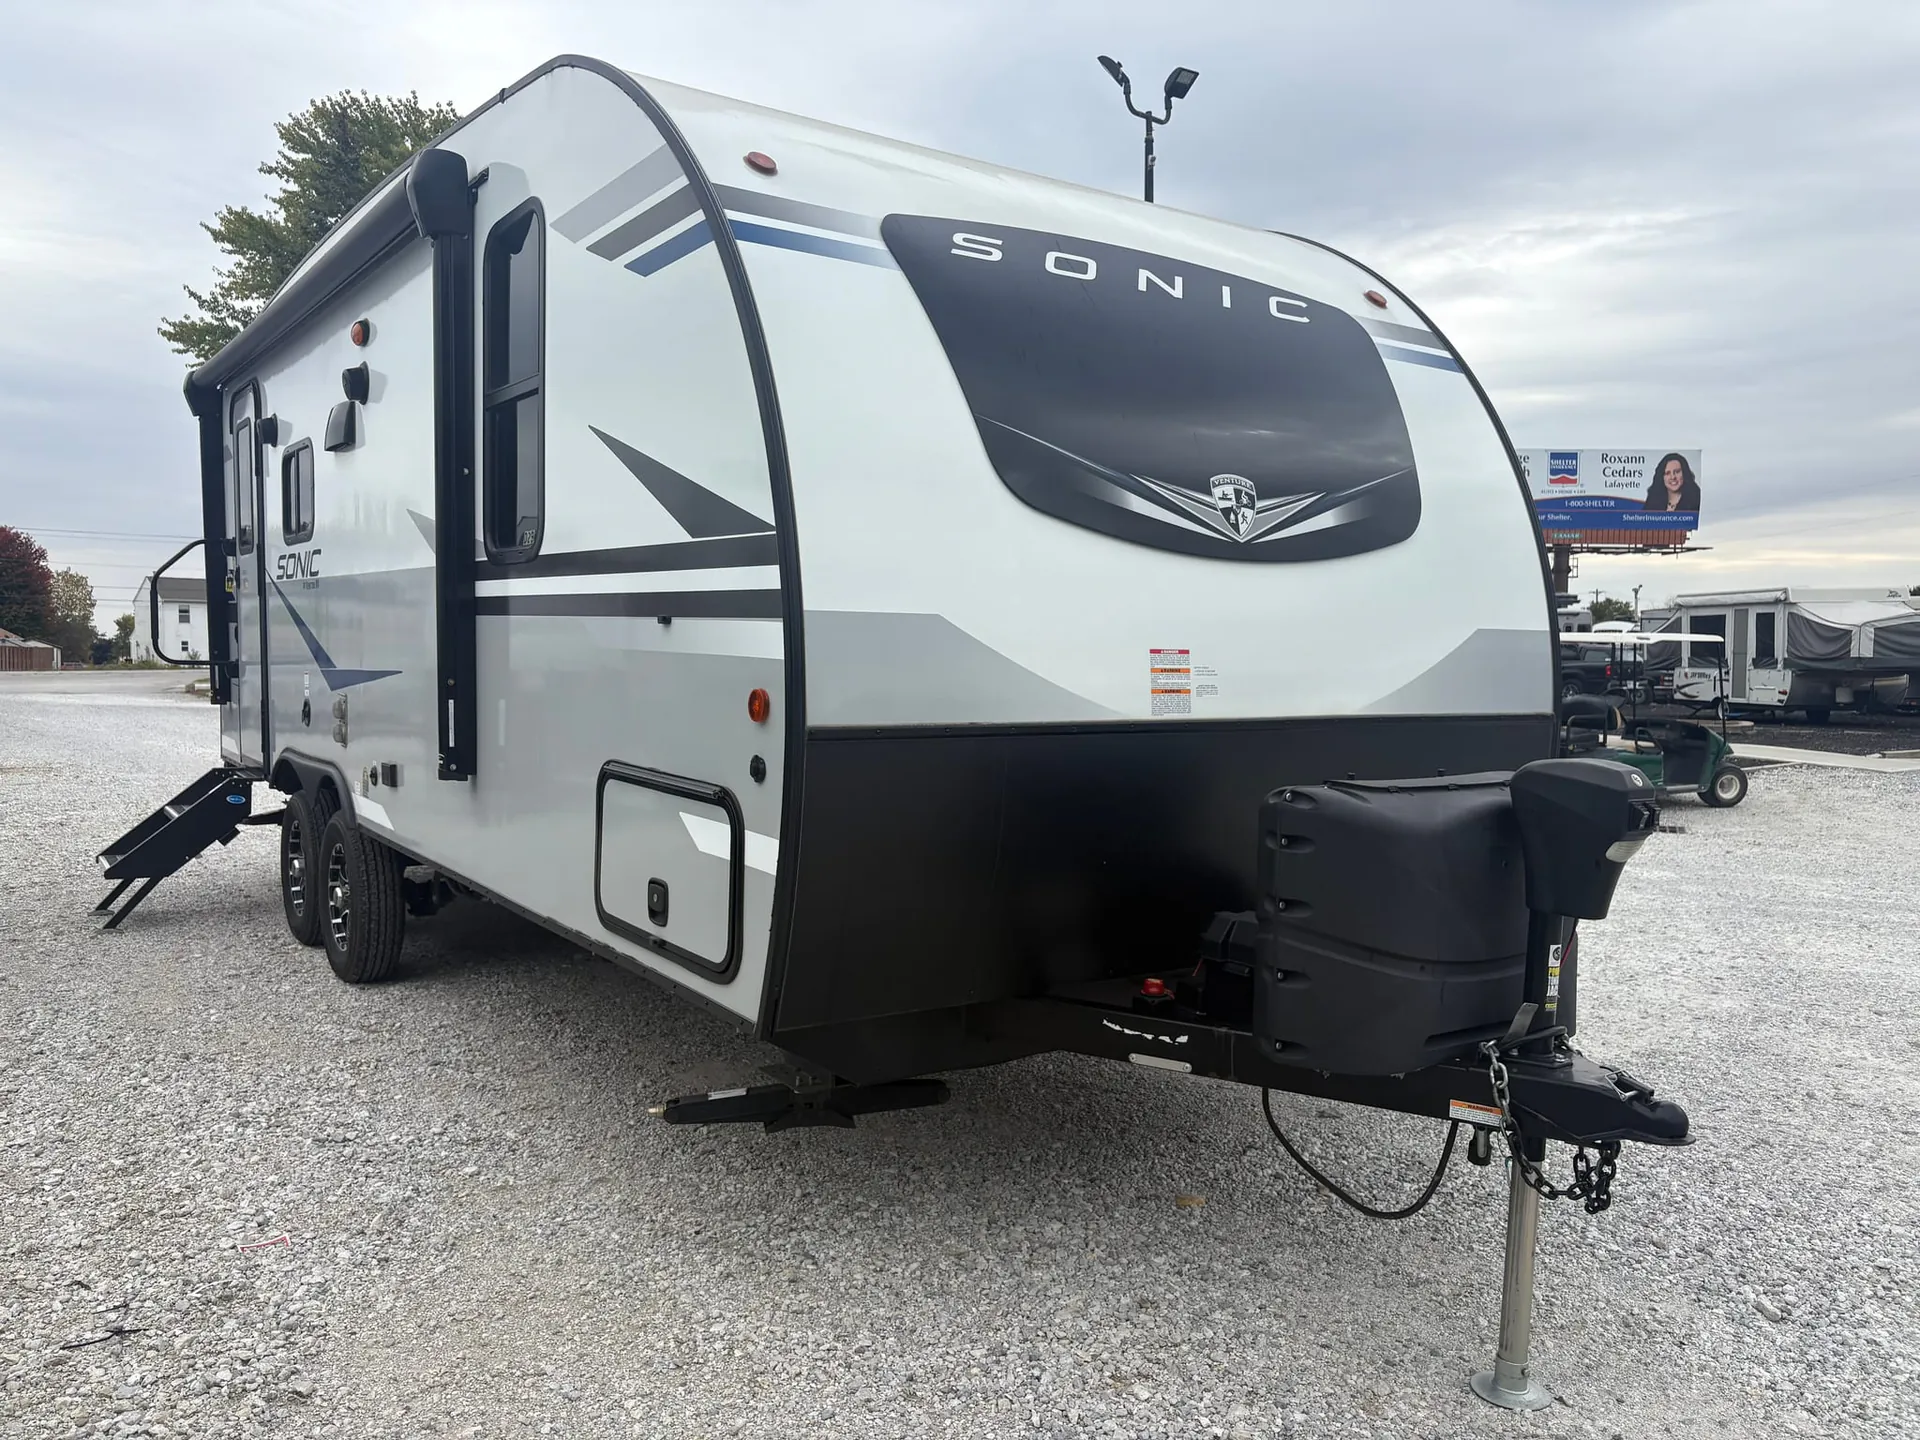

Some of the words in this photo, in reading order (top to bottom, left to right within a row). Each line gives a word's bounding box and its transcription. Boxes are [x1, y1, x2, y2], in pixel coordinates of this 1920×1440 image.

[951, 232, 1311, 323] SONIC
[1601, 452, 1645, 464] Roxann
[1602, 466, 1643, 478] Cedars
[1213, 477, 1253, 491] VENTURE
[1604, 480, 1641, 490] Lafayette
[1622, 513, 1694, 522] ShelterInsurance.com
[276, 548, 322, 580] SONIC
